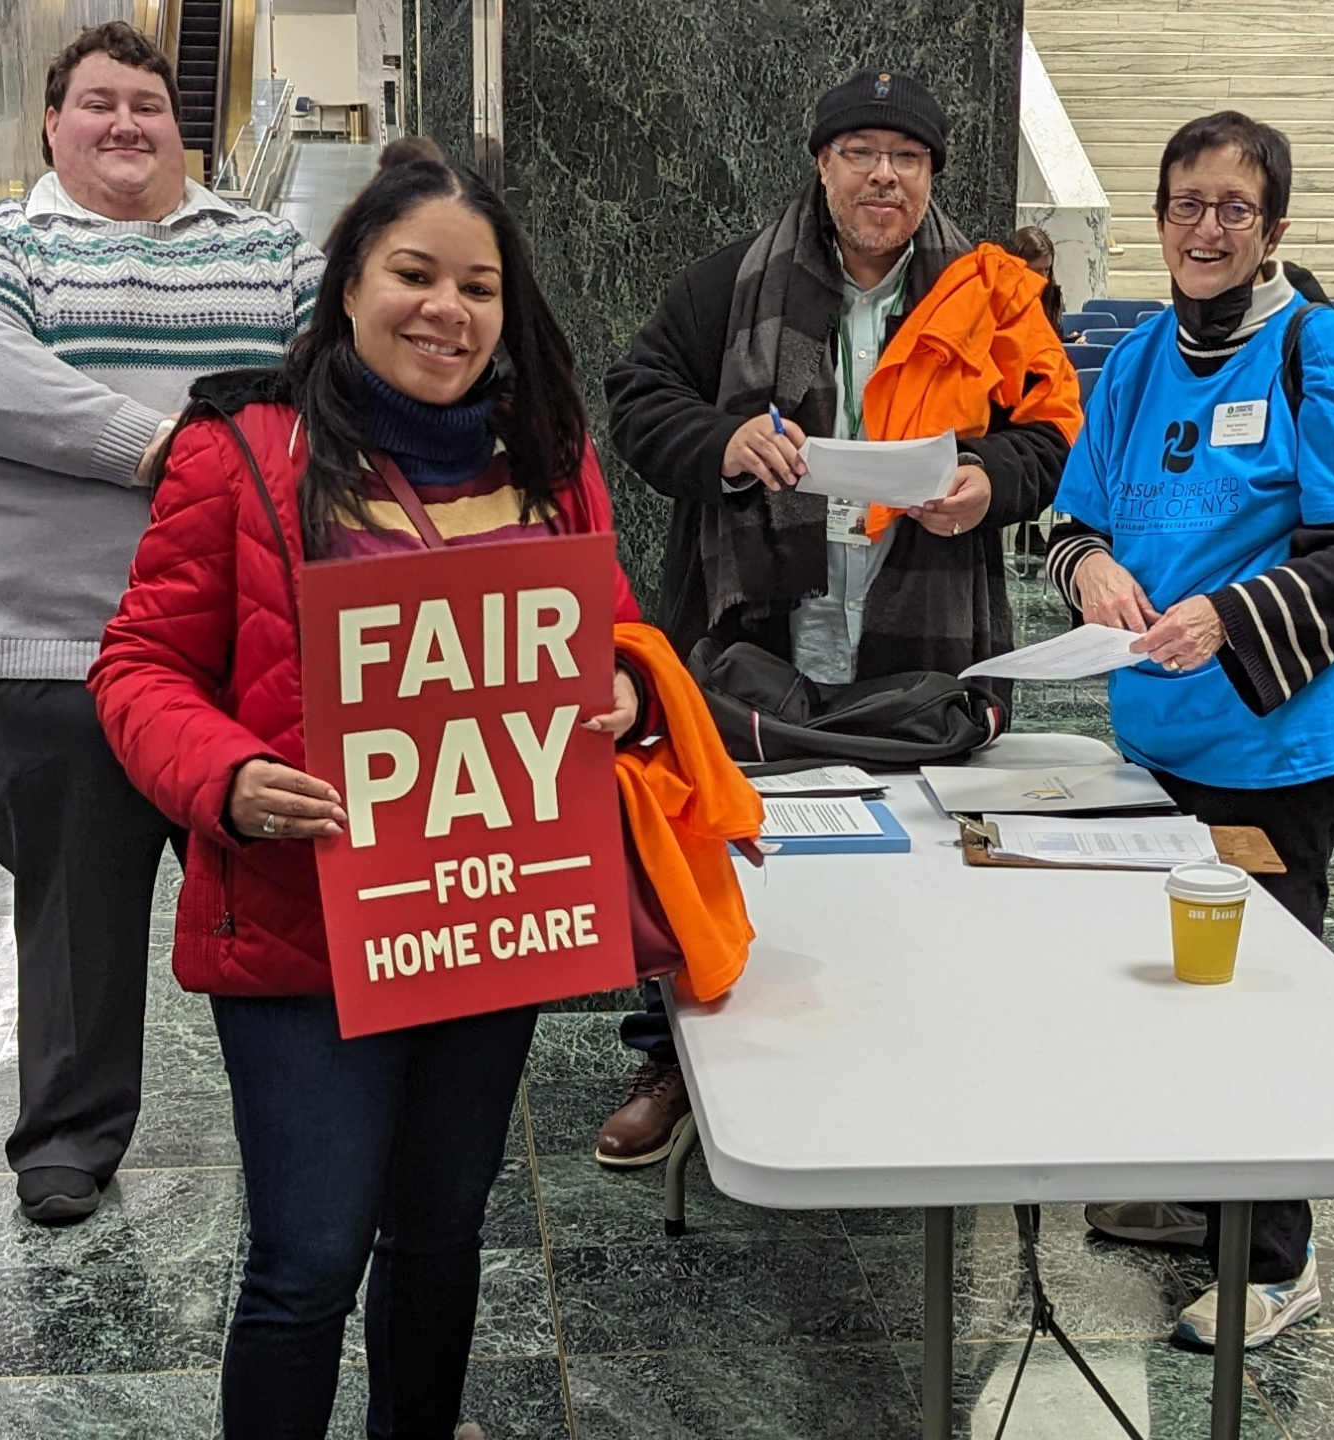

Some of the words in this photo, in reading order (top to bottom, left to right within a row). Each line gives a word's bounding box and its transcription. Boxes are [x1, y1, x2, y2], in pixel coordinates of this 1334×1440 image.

[1165, 498, 1195, 517] OF
[1200, 494, 1239, 515] NYS
[1172, 477, 1239, 497] DIRECTED
[339, 587, 581, 704] FAIR
[343, 704, 581, 849] PAY
[433, 853, 516, 903] FOR
[364, 922, 481, 982] HOME
[489, 903, 599, 959] CARE
